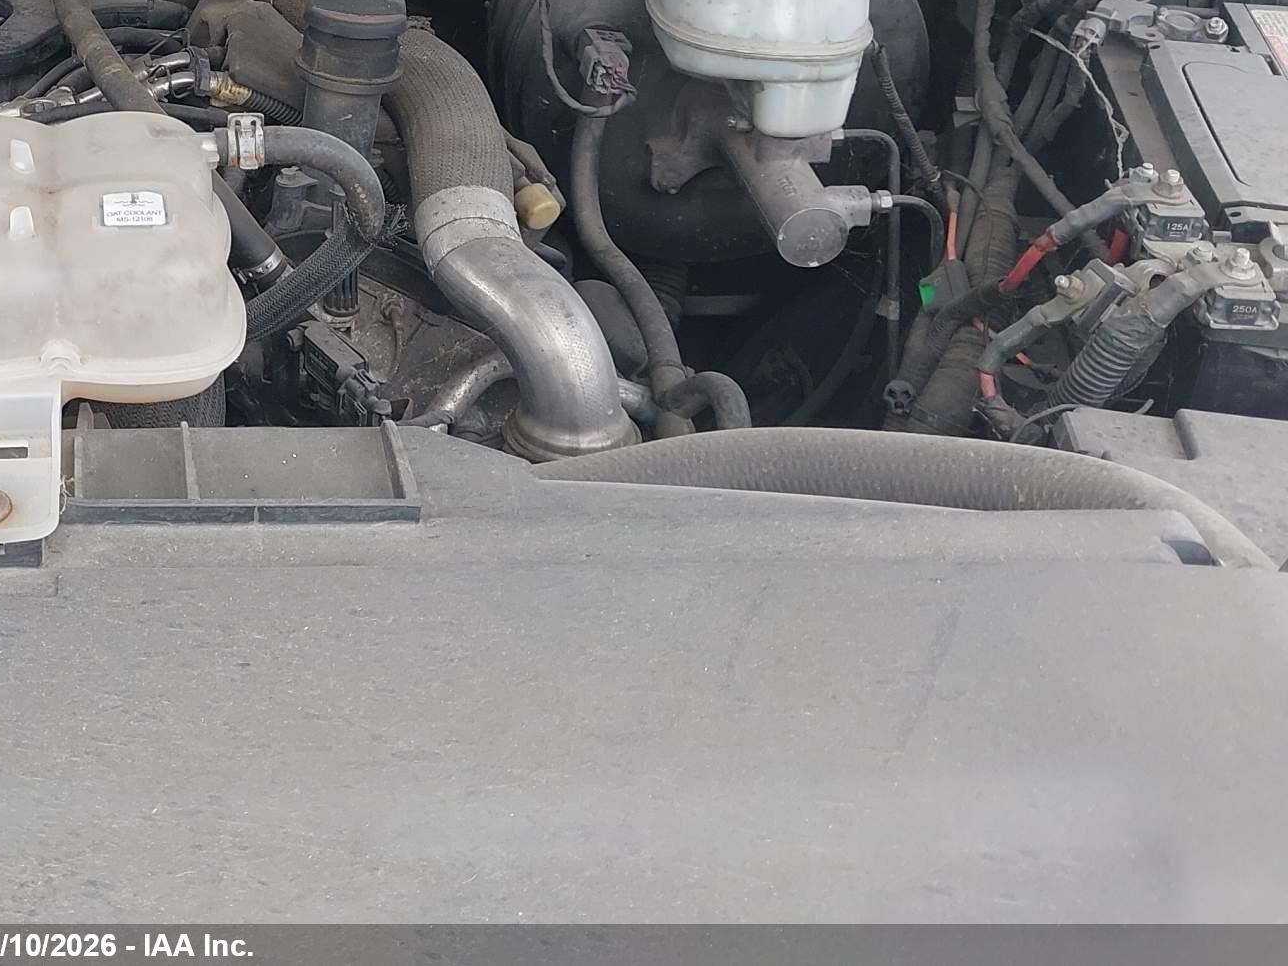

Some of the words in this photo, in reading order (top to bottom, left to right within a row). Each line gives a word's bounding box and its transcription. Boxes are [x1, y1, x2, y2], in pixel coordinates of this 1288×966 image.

[123, 209, 162, 217] COOLANT
[1166, 222, 1189, 231] 125A
[1232, 305, 1258, 314] 250A
